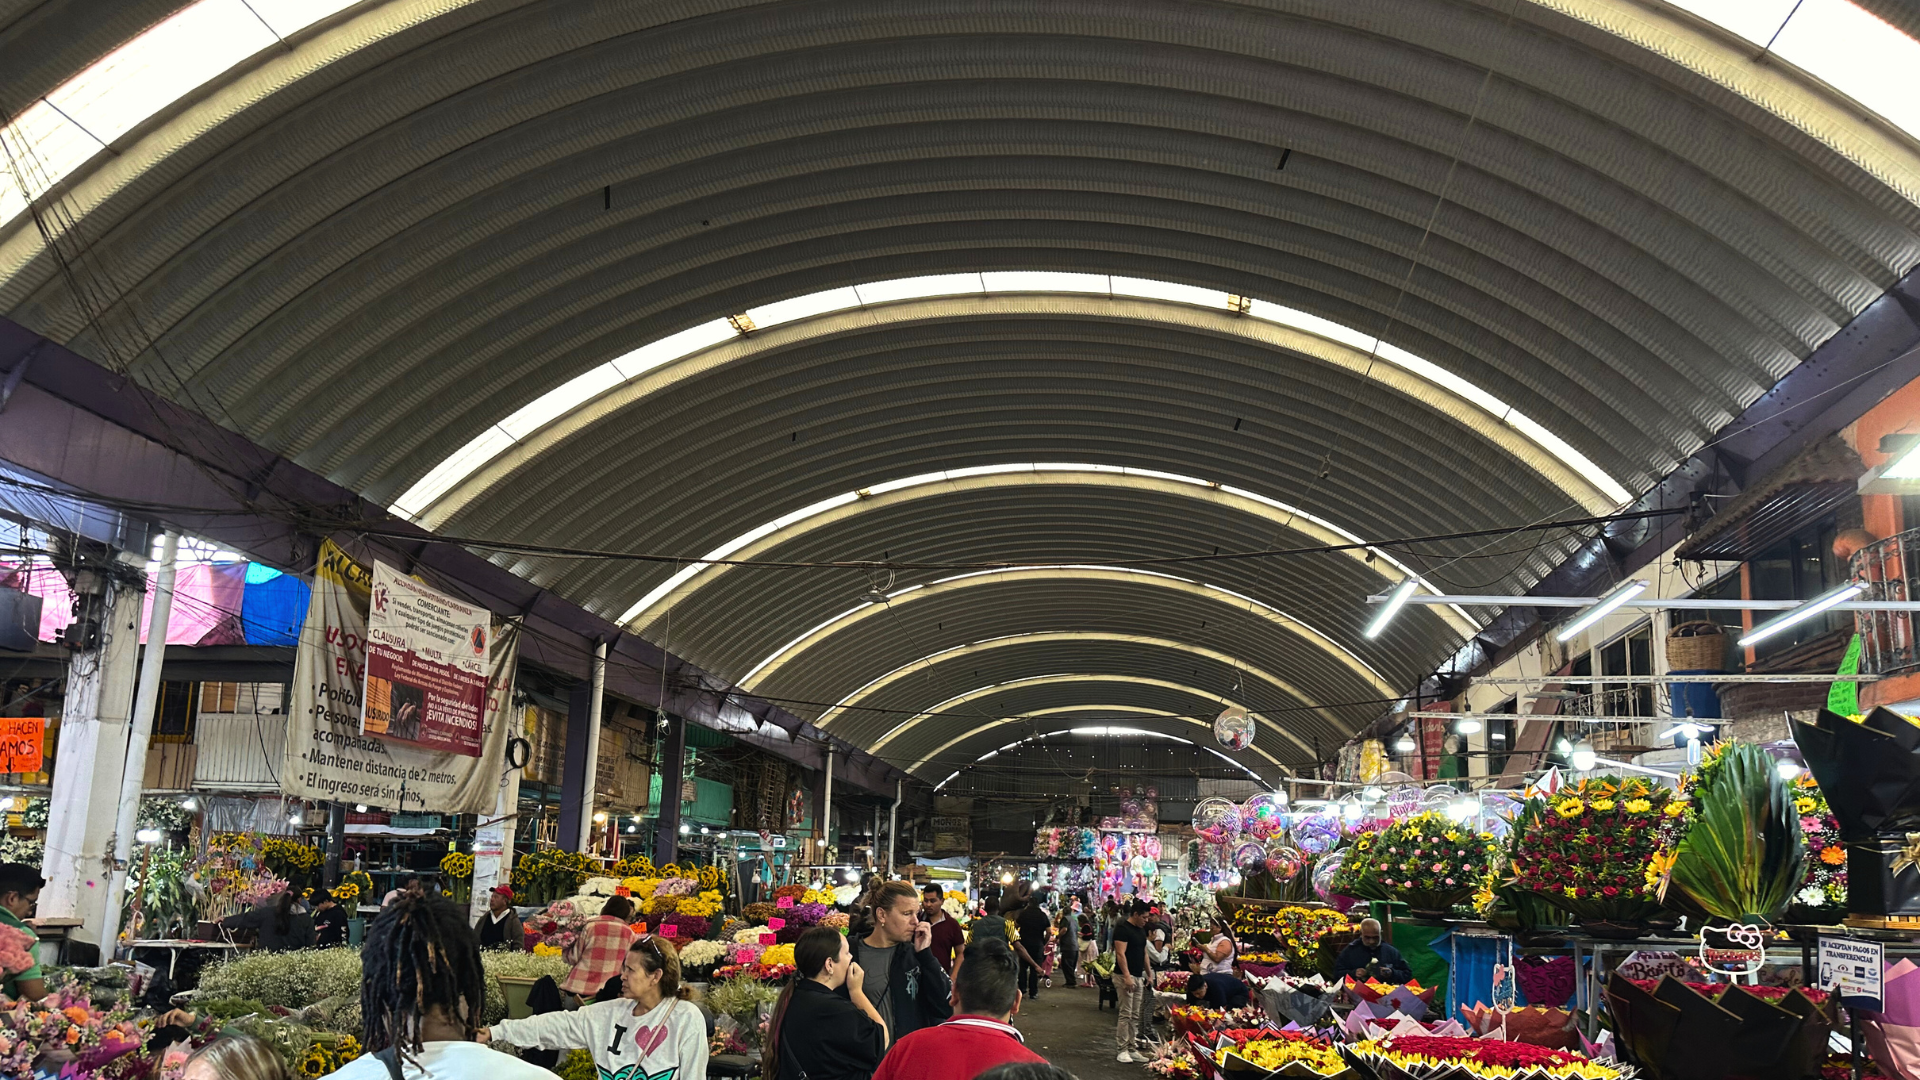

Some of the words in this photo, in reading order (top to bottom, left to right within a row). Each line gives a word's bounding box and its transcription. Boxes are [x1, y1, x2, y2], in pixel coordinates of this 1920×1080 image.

[417, 598, 452, 619] COMERCIANTE:
[372, 629, 406, 649] CLAUSURA
[368, 645, 376, 655] DE
[428, 691, 436, 701] Por
[8, 721, 39, 735] HACEN
[309, 747, 363, 773] Mantener
[365, 758, 406, 780] distancia
[408, 766, 420, 781] de
[420, 768, 427, 781] 2
[427, 771, 457, 785] metros.
[306, 771, 316, 788] El
[318, 774, 358, 795] ingreso
[358, 782, 379, 799] será
[381, 784, 395, 799] sin
[1825, 951, 1873, 964] TRANSFERENCIAS
[1828, 942, 1852, 951] ACEPTAN
[1852, 946, 1870, 954] PAGOS
[1870, 948, 1879, 956] EN
[606, 1023, 628, 1056] I
